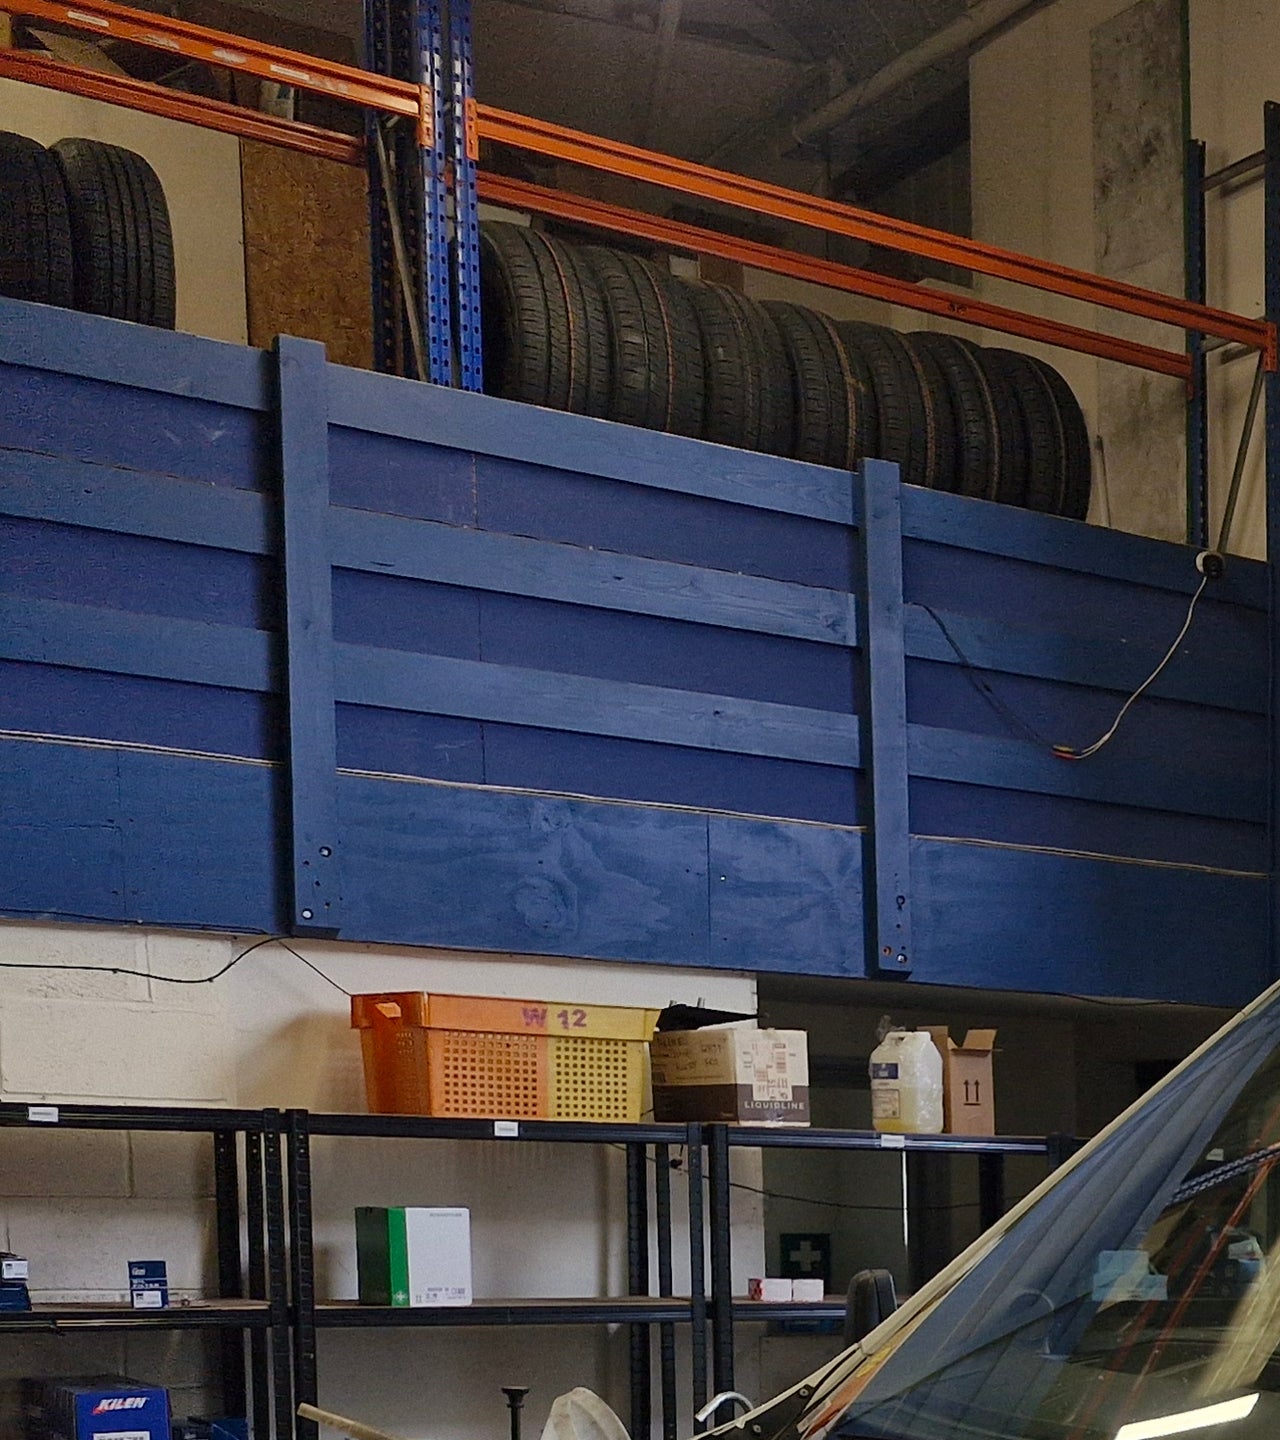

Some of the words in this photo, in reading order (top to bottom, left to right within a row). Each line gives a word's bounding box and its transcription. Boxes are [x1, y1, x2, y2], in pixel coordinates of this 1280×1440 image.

[522, 1007, 548, 1027] W
[557, 1009, 587, 1029] 12
[744, 1101, 805, 1110] LIQUIDLINE
[95, 1396, 148, 1412] KILEN
